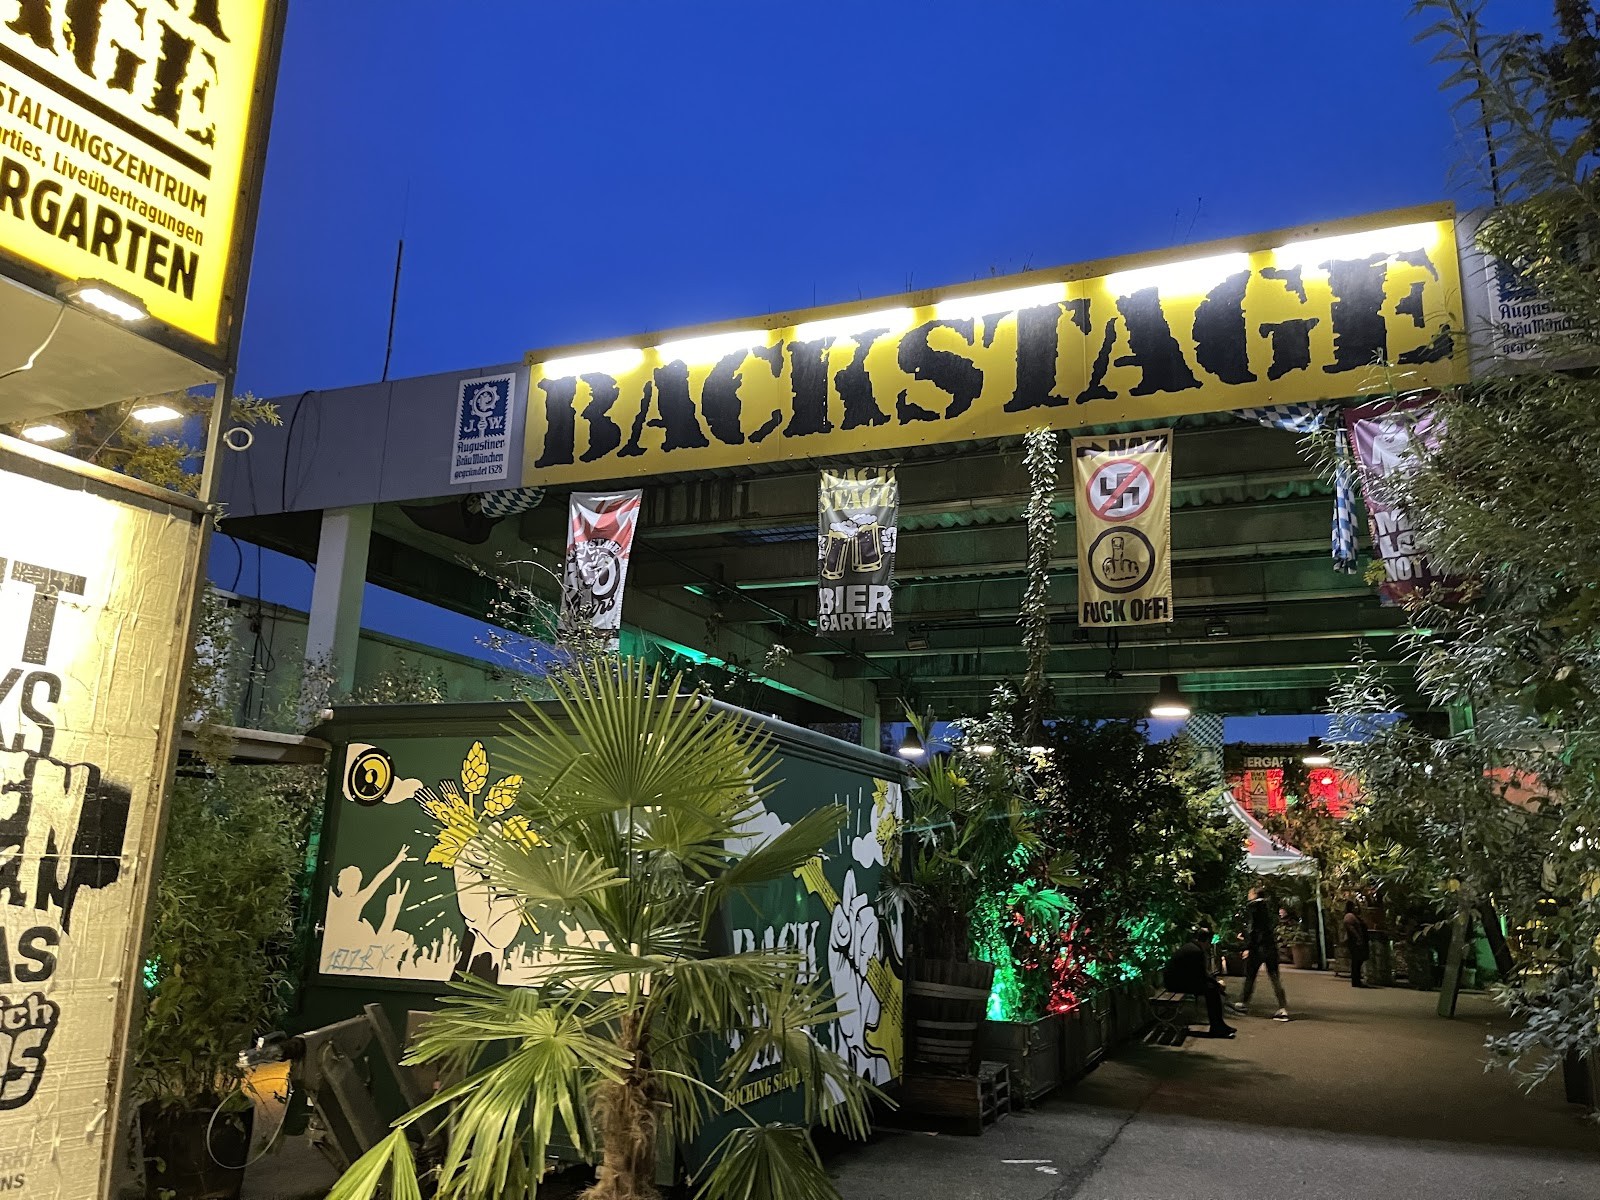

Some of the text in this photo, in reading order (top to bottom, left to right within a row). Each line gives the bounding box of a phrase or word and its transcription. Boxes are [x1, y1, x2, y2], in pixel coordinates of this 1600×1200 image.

[0, 125, 204, 247] rties, Liveübertragungen
[0, 155, 200, 301] RGARTEN
[535, 246, 1454, 468] BACKSTAGE
[457, 439, 505, 455] Augustiner
[820, 485, 896, 513] STAGE
[819, 584, 893, 614] BIER
[1083, 596, 1169, 623] FUCK OFF!
[819, 611, 893, 632] GARTEN
